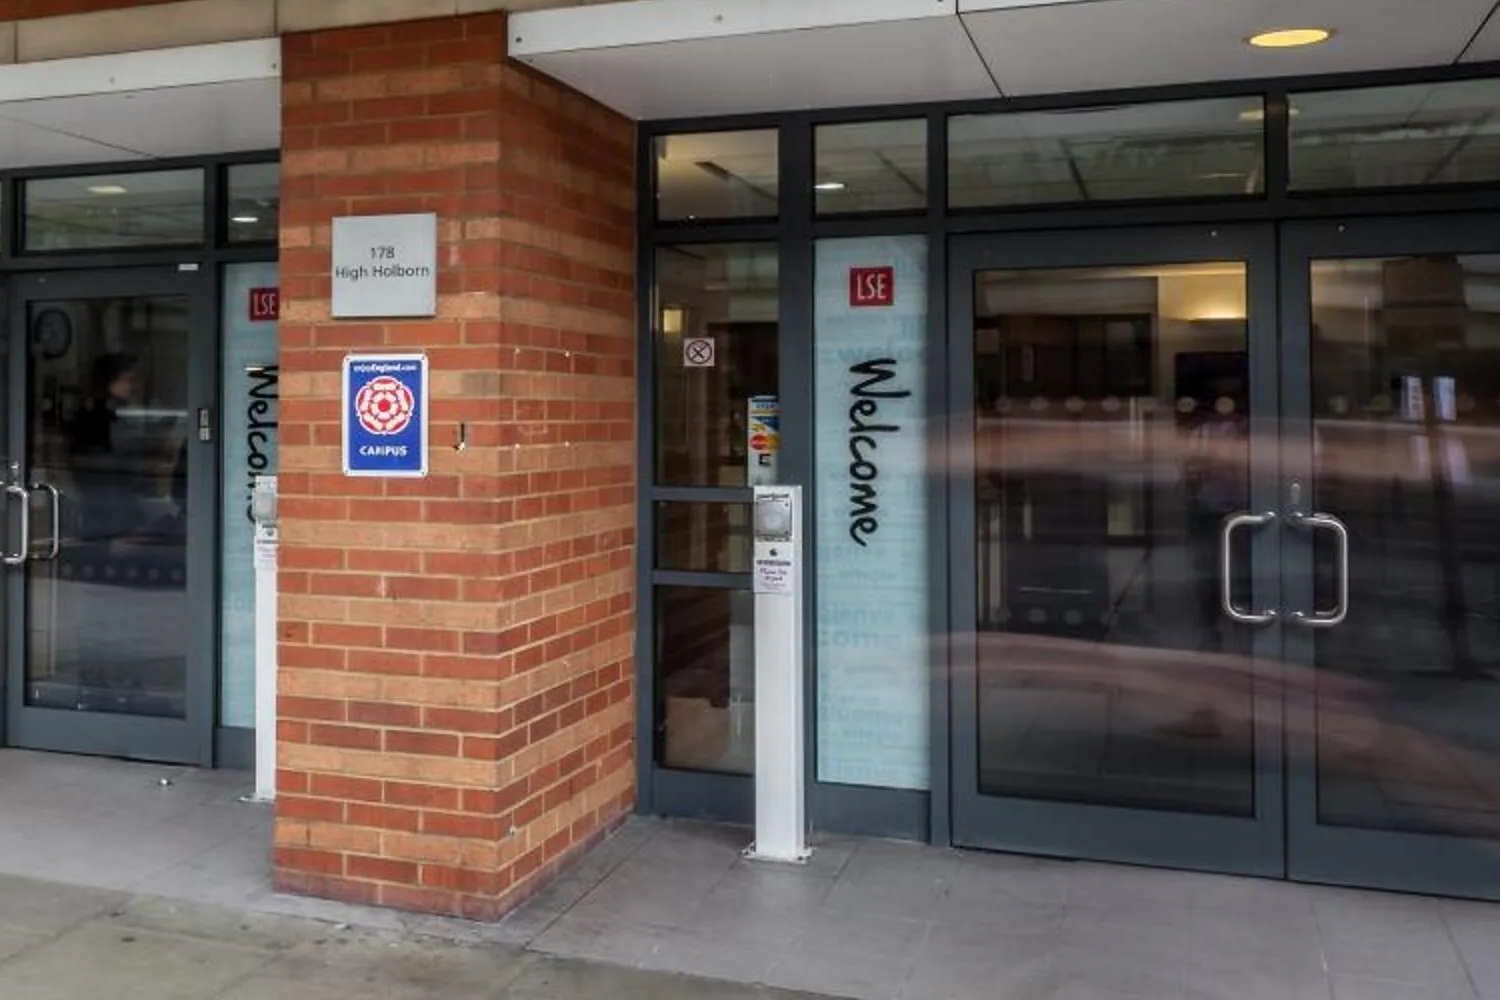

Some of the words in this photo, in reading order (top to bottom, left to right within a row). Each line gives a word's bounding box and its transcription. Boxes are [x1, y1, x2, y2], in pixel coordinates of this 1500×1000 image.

[371, 246, 395, 259] 178
[335, 265, 369, 281] High
[373, 265, 430, 278] Holborn
[857, 273, 886, 300] LSE
[253, 293, 277, 316] LSE
[246, 365, 278, 523] Welco
[359, 445, 408, 457] CAMPUS
[849, 357, 912, 548] Welcome
